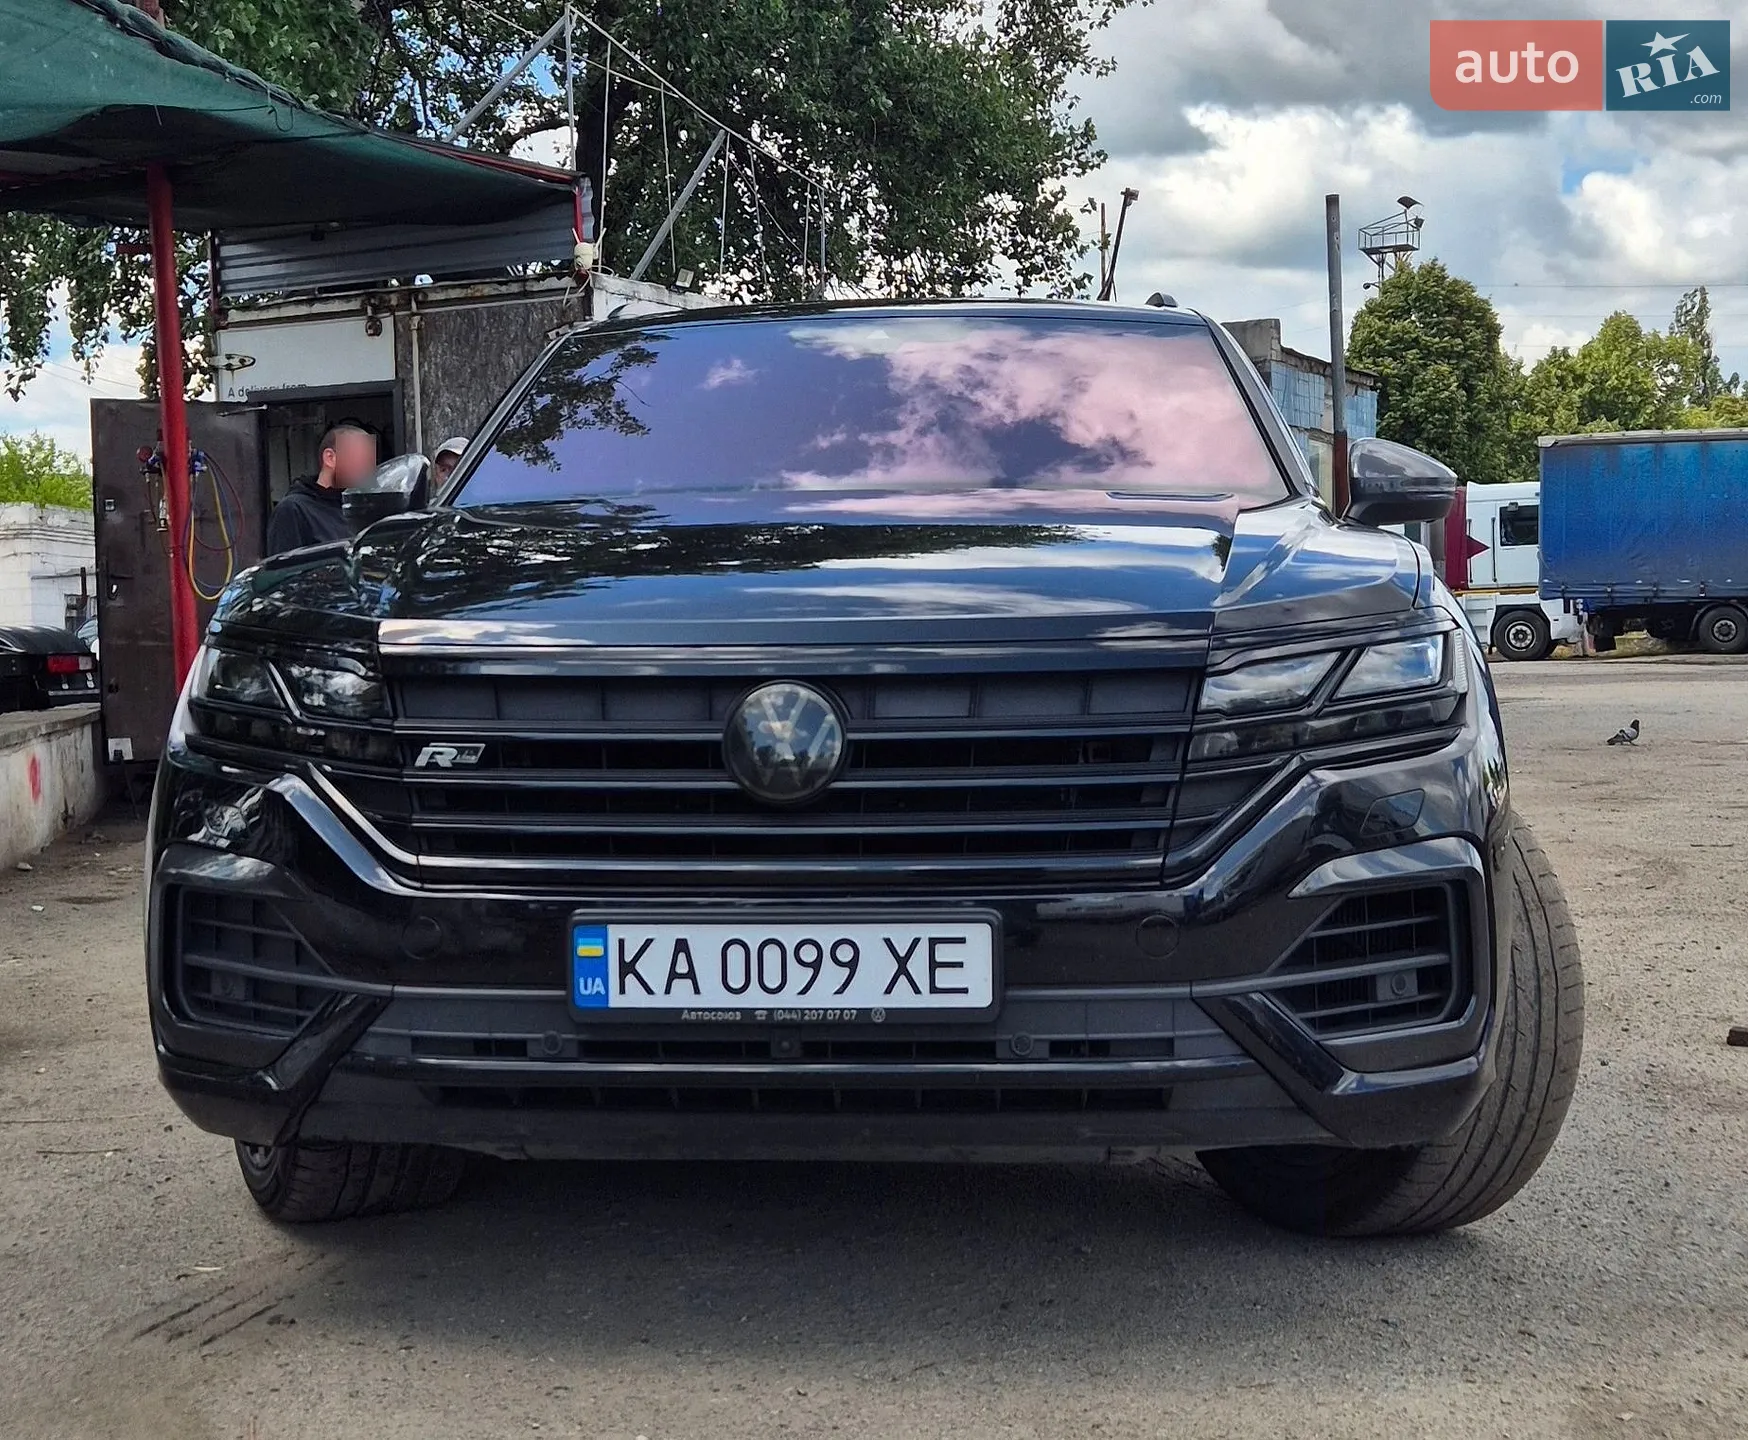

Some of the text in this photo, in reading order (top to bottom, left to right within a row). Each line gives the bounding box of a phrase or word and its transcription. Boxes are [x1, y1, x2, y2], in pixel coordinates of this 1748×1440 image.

[228, 387, 235, 398] A
[618, 937, 970, 995] KA 0099 XE
[579, 977, 606, 996] UA
[803, 1010, 823, 1020] 207
[826, 1010, 840, 1020] 07
[843, 1010, 857, 1020] 07
